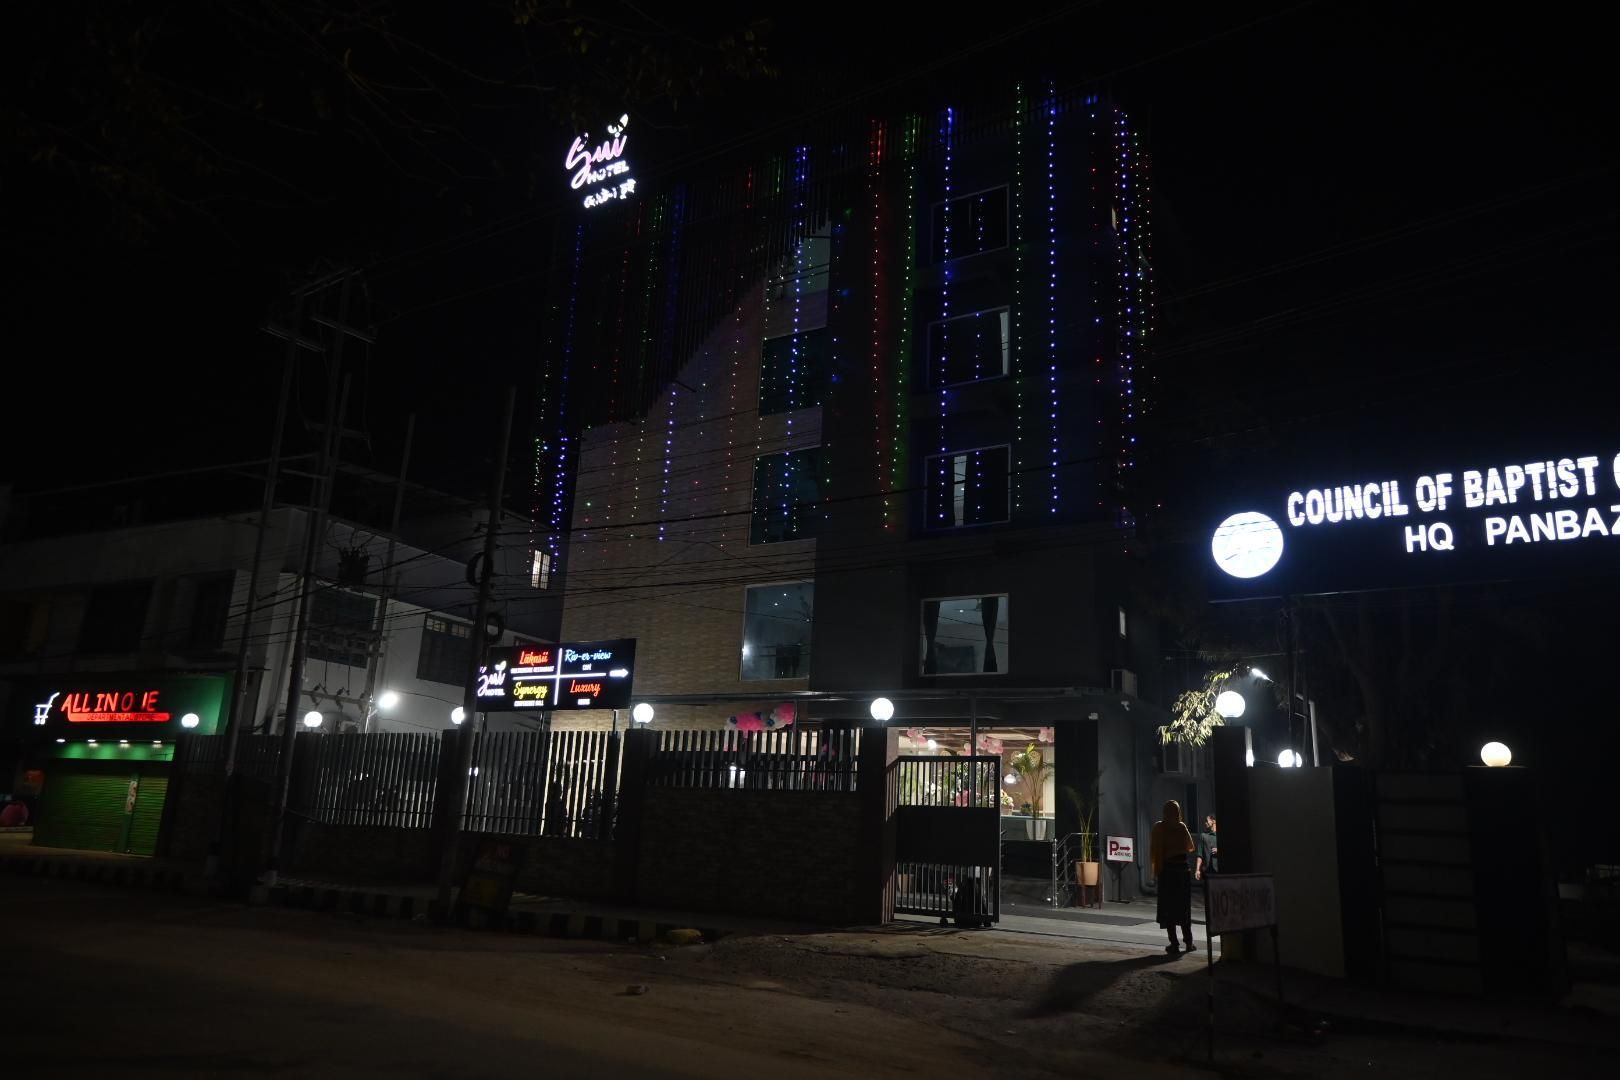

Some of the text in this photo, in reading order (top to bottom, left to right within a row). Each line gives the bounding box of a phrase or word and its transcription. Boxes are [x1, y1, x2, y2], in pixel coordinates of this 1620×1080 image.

[586, 160, 630, 184] HOTEL
[1287, 480, 1409, 527] COUNCIL
[1415, 473, 1453, 512] OF
[1463, 456, 1599, 508] BAPTIST
[1404, 522, 1455, 552] HQ
[513, 681, 548, 700] Synergy
[569, 679, 601, 697] Luxury
[60, 692, 91, 713] ALL
[93, 691, 119, 713] IN
